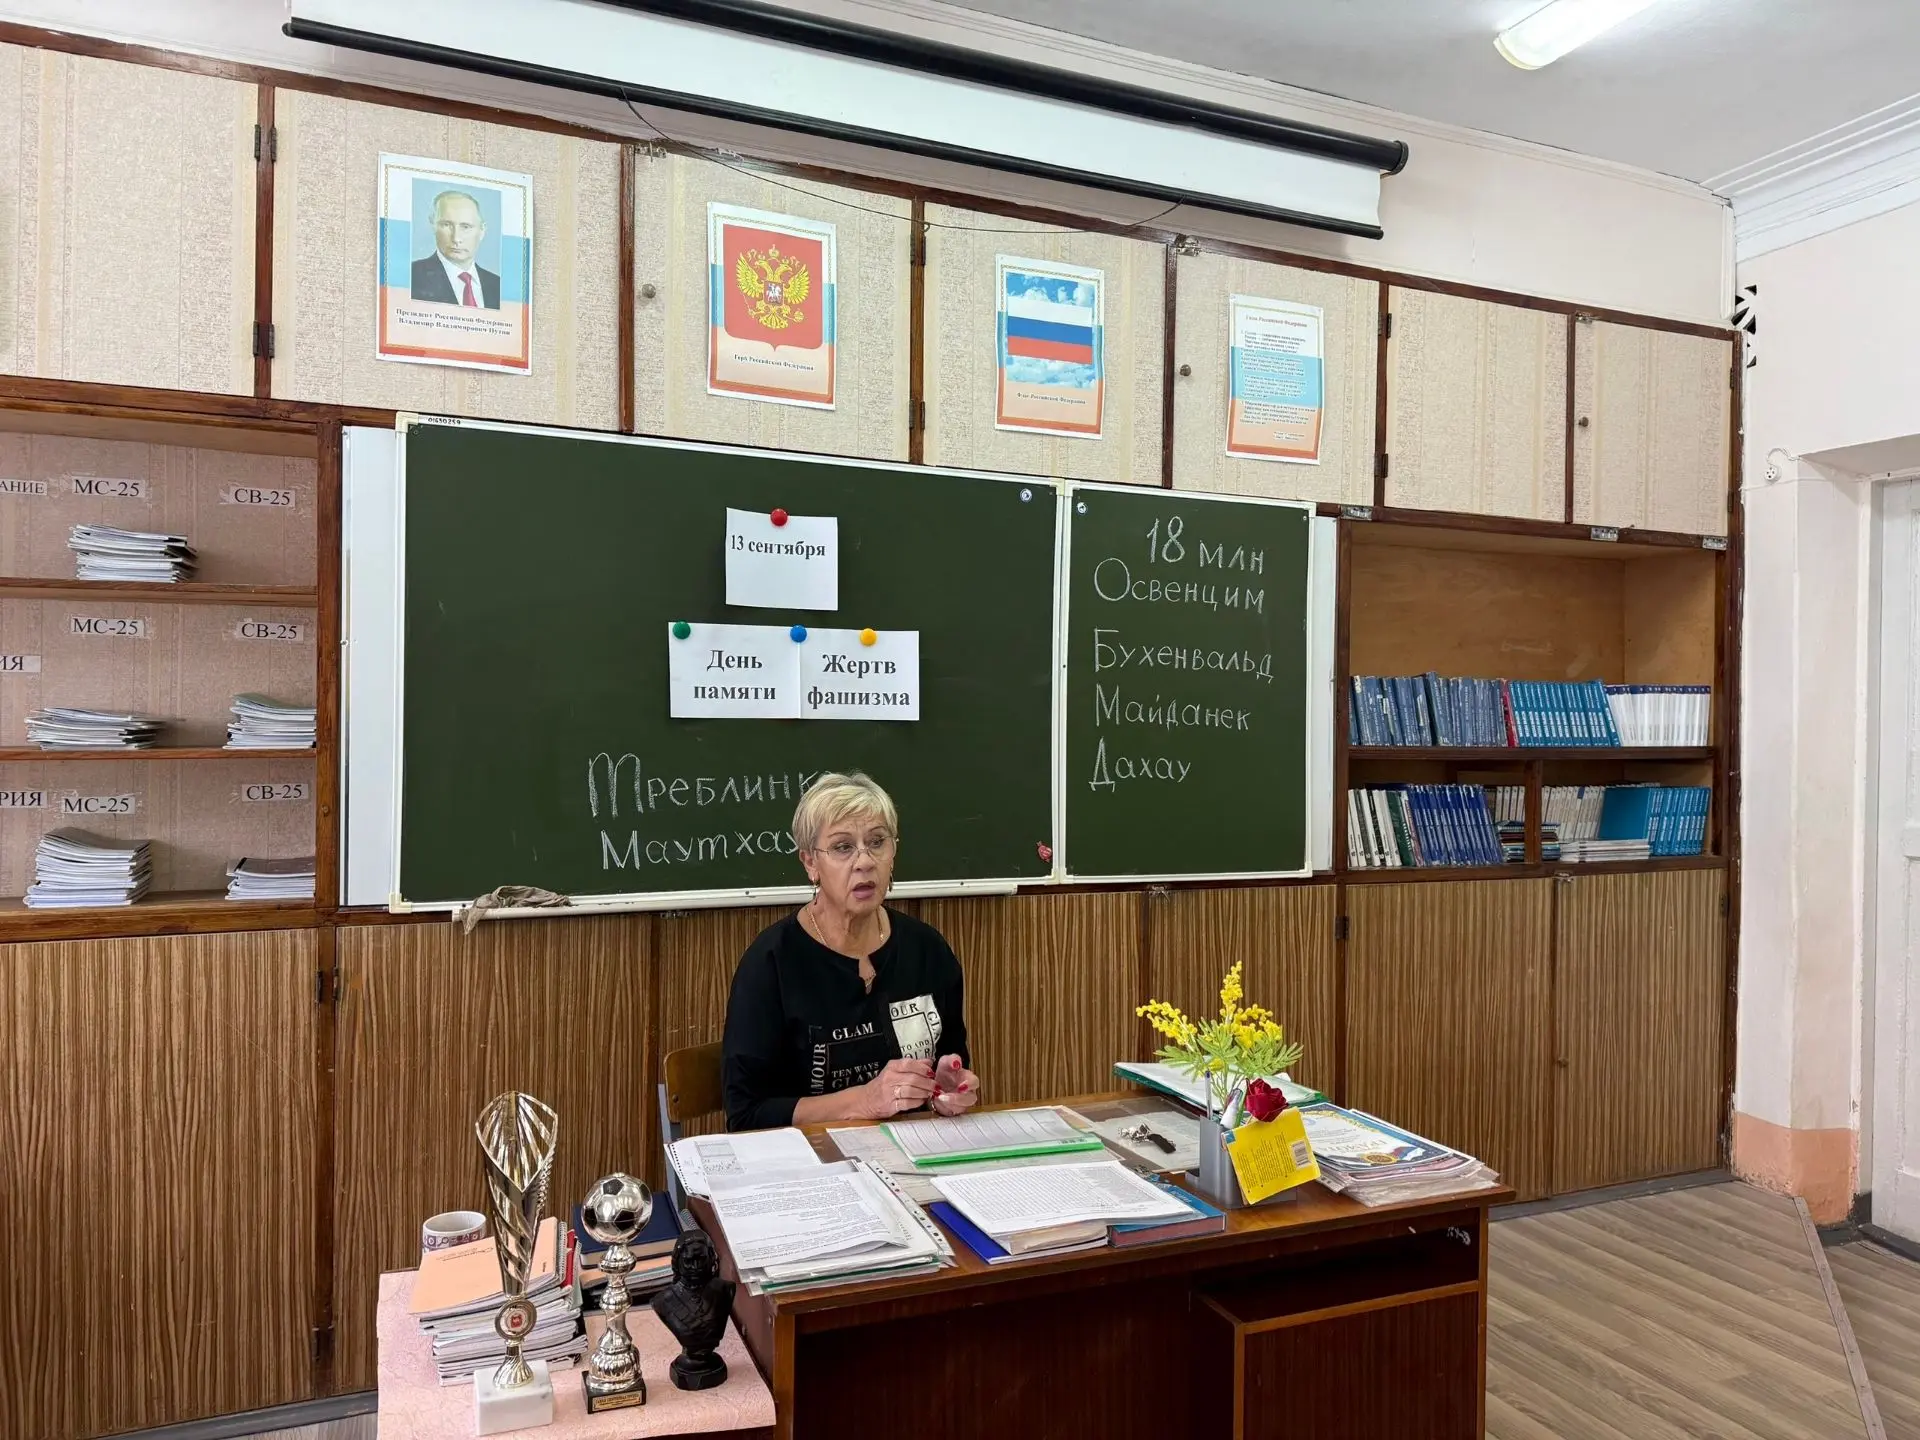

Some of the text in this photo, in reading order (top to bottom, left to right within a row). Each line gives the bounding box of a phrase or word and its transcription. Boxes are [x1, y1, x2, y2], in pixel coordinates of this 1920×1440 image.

[74, 478, 140, 497] МС-25
[234, 487, 291, 506] СВ-25
[731, 535, 826, 560] 13 сентября
[1146, 515, 1186, 563] 18
[1094, 557, 1265, 614] Освенцим
[72, 617, 138, 635] МС-25
[241, 622, 297, 640] СВ-25
[706, 649, 763, 672] День
[822, 653, 897, 679] Жертв
[1094, 627, 1275, 684] Бухенвальд
[693, 685, 776, 701] памяти
[807, 685, 911, 710] фашизма
[1095, 683, 1251, 731] Майданек
[1088, 736, 1191, 793] Дахау
[246, 784, 303, 800] СВ-25
[588, 752, 832, 818] Треблинк
[0, 791, 42, 806] РИЯ
[63, 796, 130, 813] МС-25
[832, 1003, 919, 1041] GLAM OUR
[831, 1067, 852, 1078] TEN
[854, 1061, 880, 1073] WAYS
